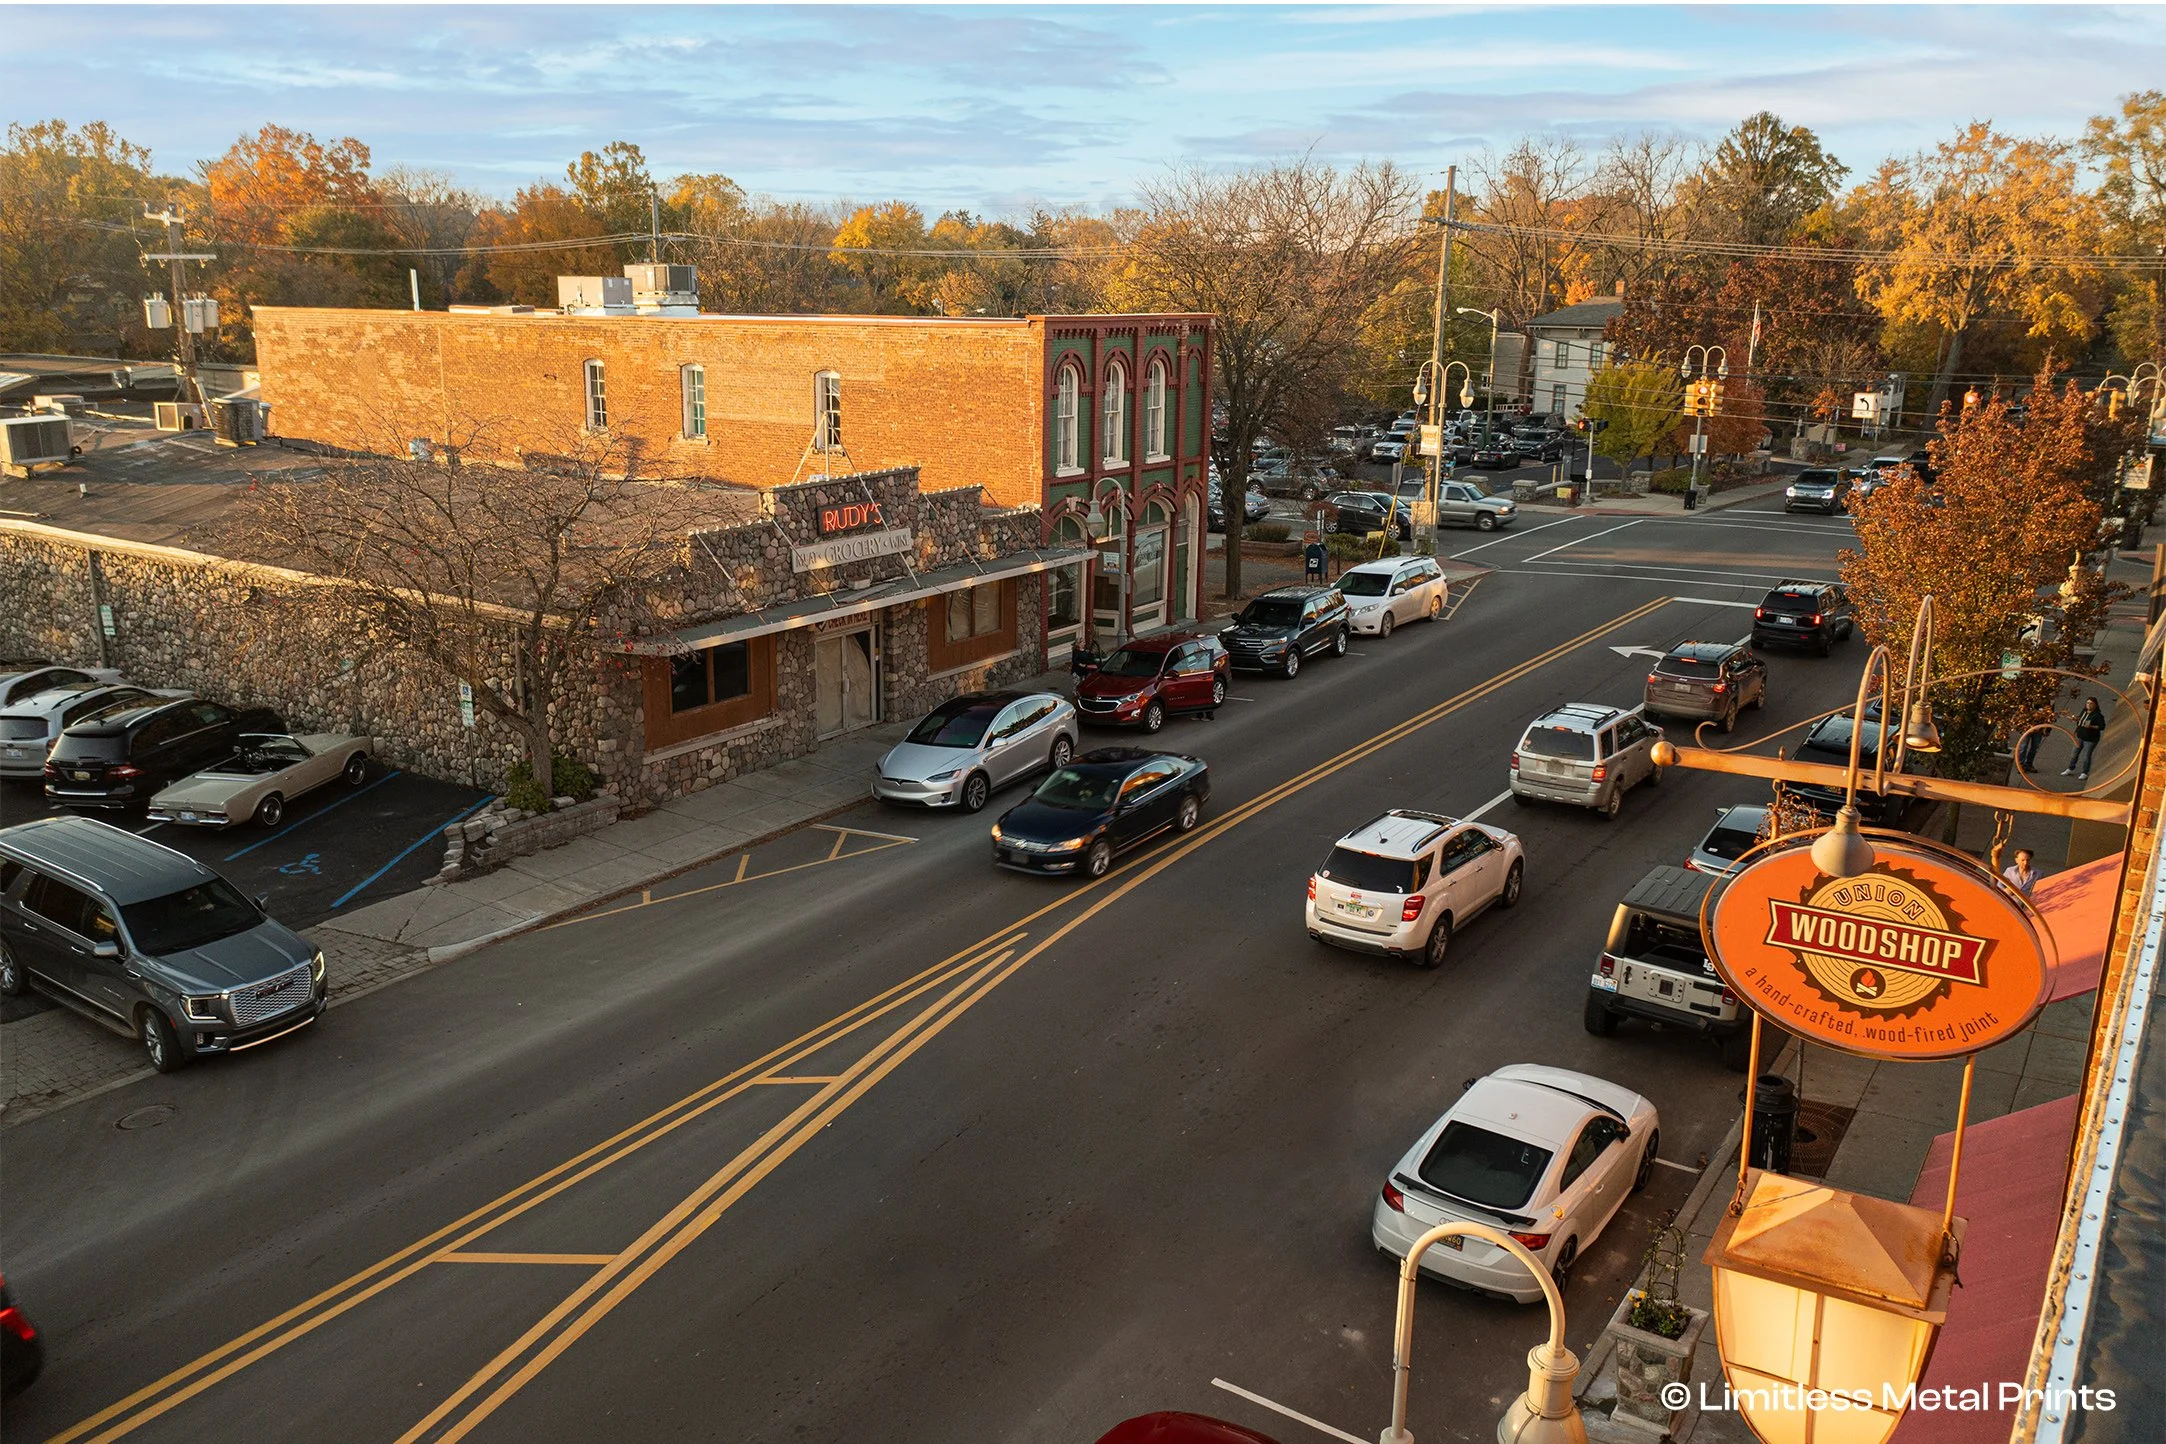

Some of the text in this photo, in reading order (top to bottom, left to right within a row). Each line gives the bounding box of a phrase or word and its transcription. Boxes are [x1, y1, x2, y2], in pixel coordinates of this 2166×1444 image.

[824, 502, 882, 531] RUDY'S
[825, 537, 881, 563] GROCERY
[1834, 883, 1926, 920] UNION
[1791, 911, 1963, 969] WOODSHOP
[1745, 967, 1756, 978] a
[1959, 1011, 1999, 1043] joint
